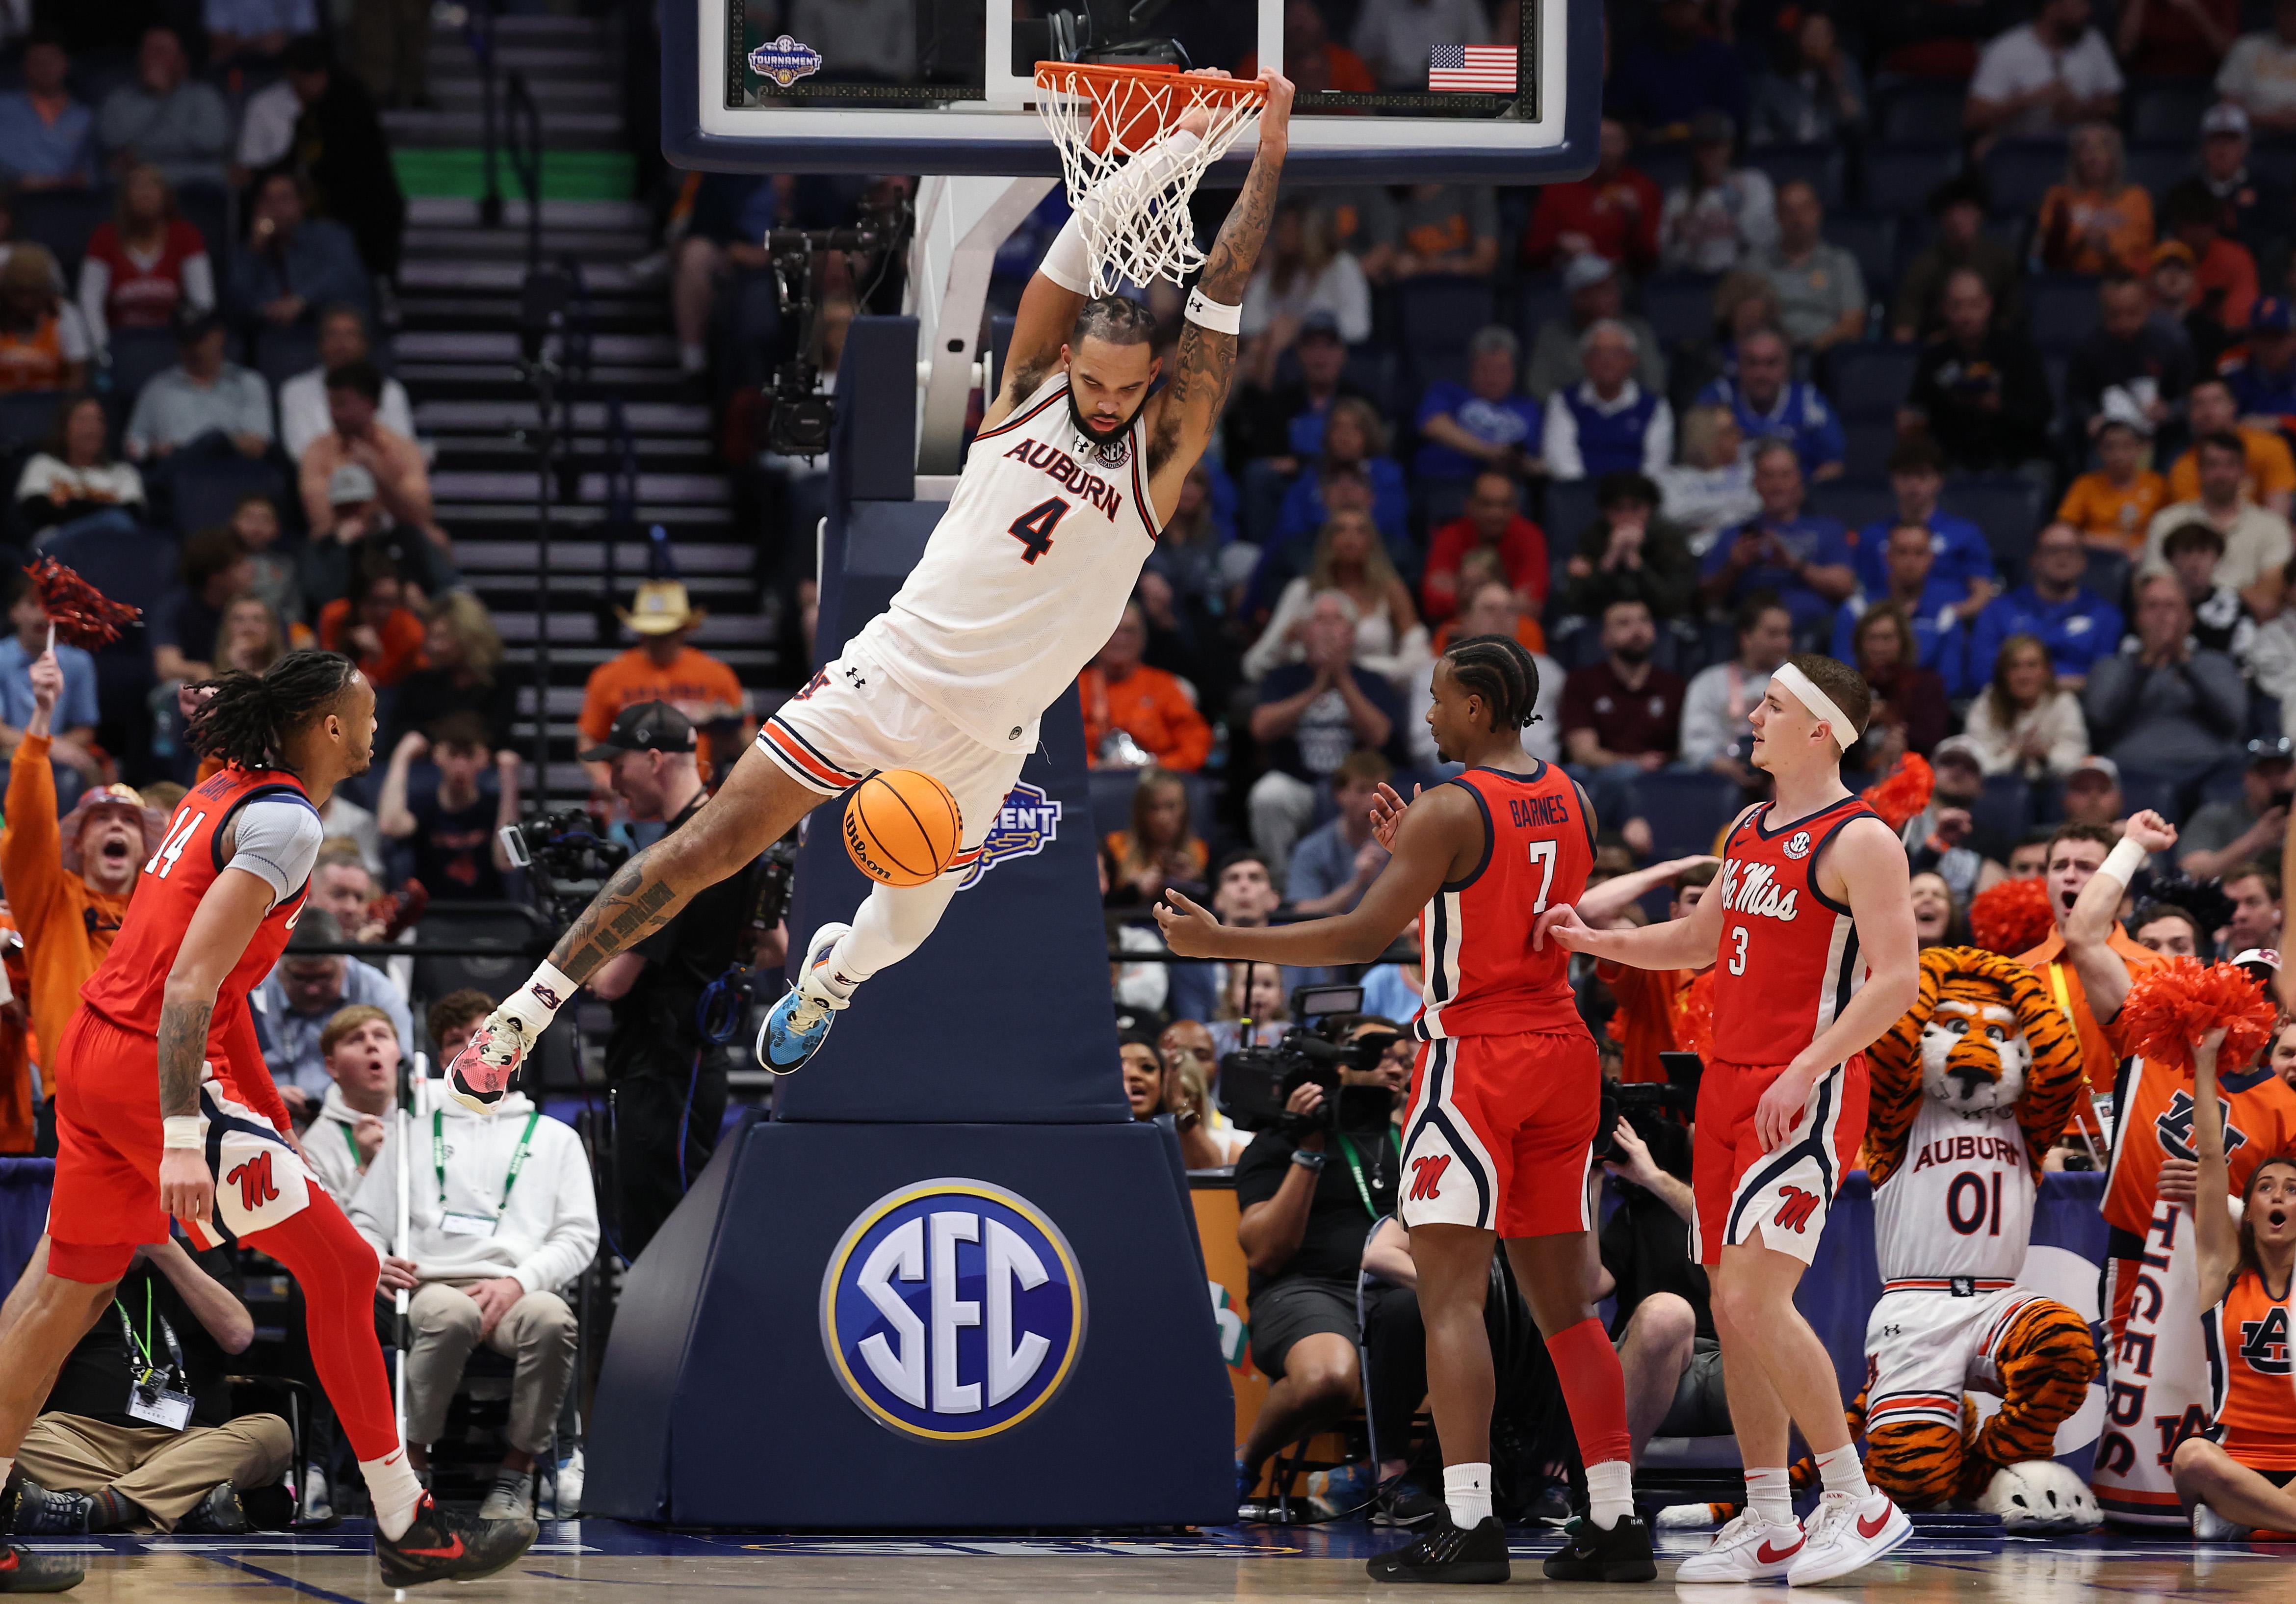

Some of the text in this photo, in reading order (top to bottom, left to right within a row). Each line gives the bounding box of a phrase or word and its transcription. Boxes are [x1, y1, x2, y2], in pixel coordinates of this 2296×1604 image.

[751, 55, 819, 67] TOURNAMENT
[779, 38, 792, 53] SEC
[1002, 438, 1122, 523] AUBURN
[1098, 458, 1126, 468] GRADUATE
[1007, 495, 1071, 565] 4
[1509, 794, 1568, 827] BARNES
[1790, 831, 1810, 852] SEC
[144, 805, 206, 879] 14
[845, 809, 892, 880] Wilson
[1783, 845, 1804, 859] GRADUATE
[1529, 839, 1557, 915] 7
[1735, 862, 1799, 921] Miss
[1728, 925, 1749, 977] 3
[1946, 1171, 2002, 1236] 01
[857, 1211, 1051, 1414] SEC
[2095, 1204, 2181, 1478] TIGERS
